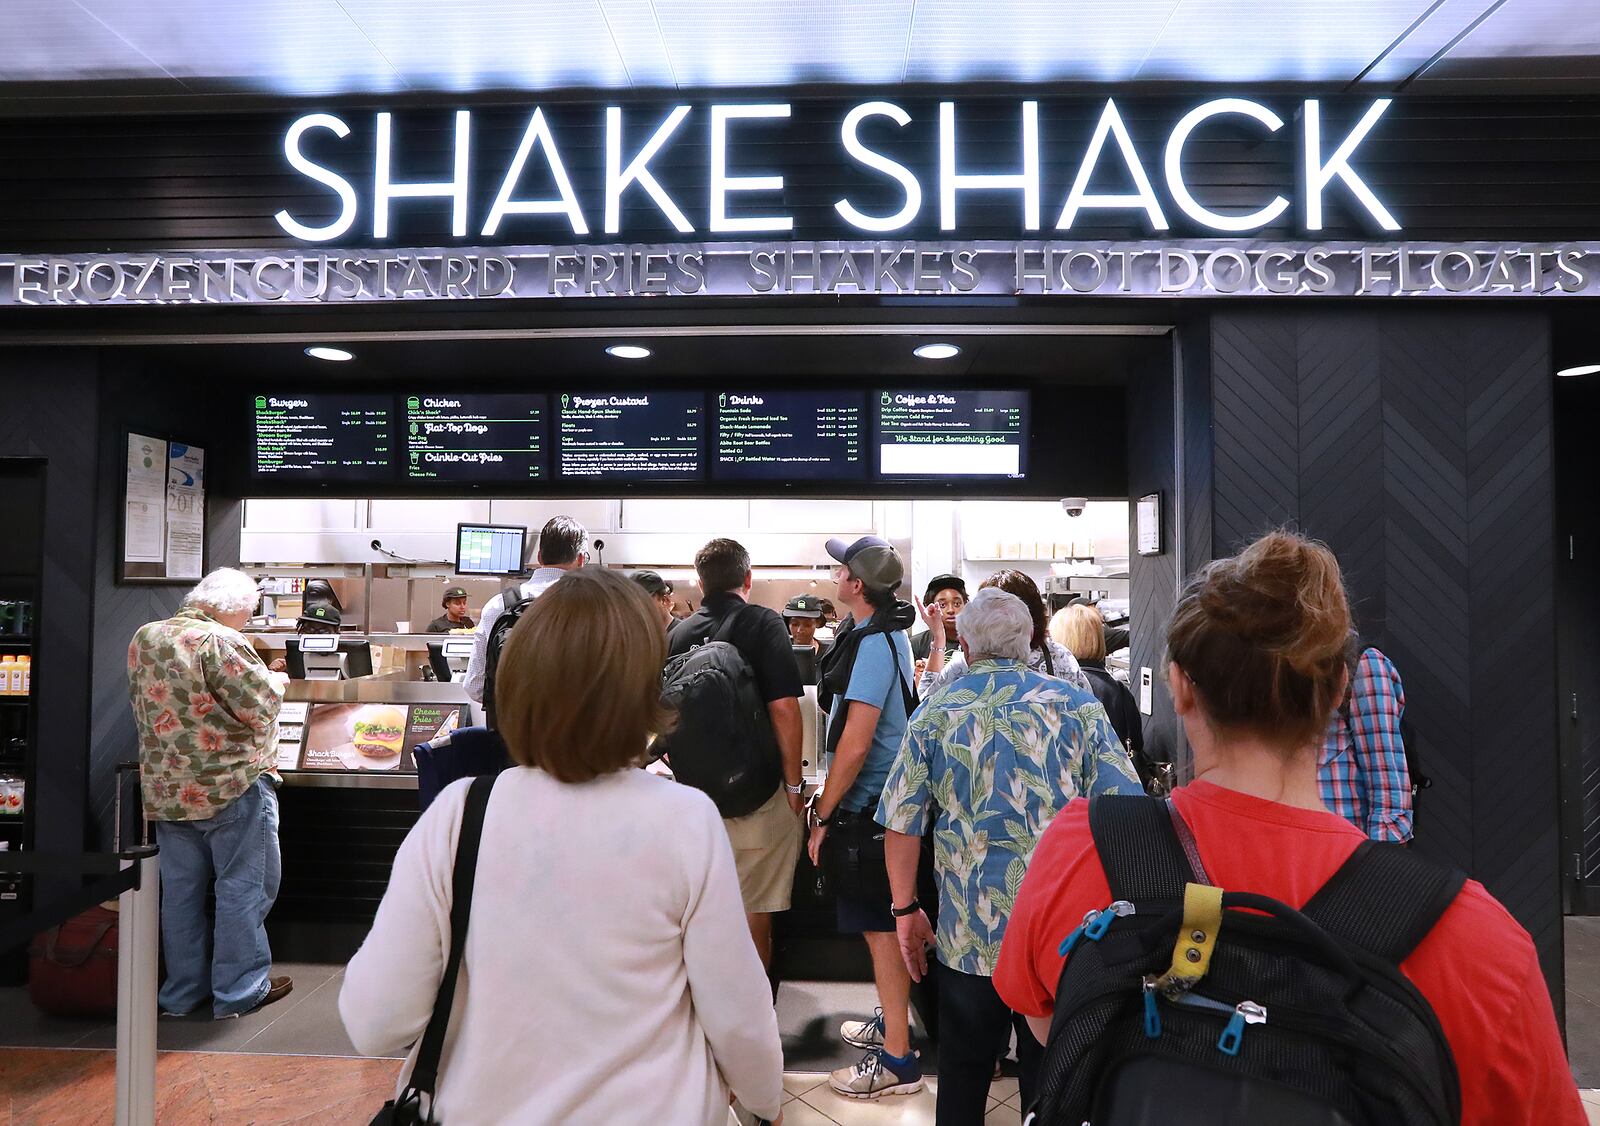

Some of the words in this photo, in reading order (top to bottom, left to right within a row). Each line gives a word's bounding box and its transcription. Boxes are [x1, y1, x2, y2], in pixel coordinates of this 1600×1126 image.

[274, 103, 794, 242] SHAKE
[834, 97, 1402, 232] SHACK
[12, 257, 235, 303] FROZEN
[249, 253, 513, 300] CUSTARD
[547, 246, 704, 295] FRIES
[747, 246, 981, 293] SHAKES
[1015, 247, 1145, 293] HOT
[1160, 247, 1336, 293] DOGS
[1361, 247, 1590, 293] FLOATS
[269, 398, 308, 409] Burgers
[424, 398, 461, 407] Chicken
[573, 397, 609, 408] Frozen
[608, 396, 649, 406] Custard
[730, 395, 763, 405] Drinks
[895, 395, 927, 406] Coffee
[927, 395, 937, 404] &
[936, 395, 956, 404] Tea
[424, 423, 464, 434] Flat-Top
[463, 423, 488, 434] Dogs
[895, 435, 909, 443] We
[909, 435, 931, 443] Stand
[932, 435, 944, 444] for
[945, 435, 985, 444] Something
[984, 435, 1007, 444] Good
[425, 453, 480, 462] Crinkle-Cut
[478, 453, 503, 464] Fries
[413, 716, 433, 724] Fries
